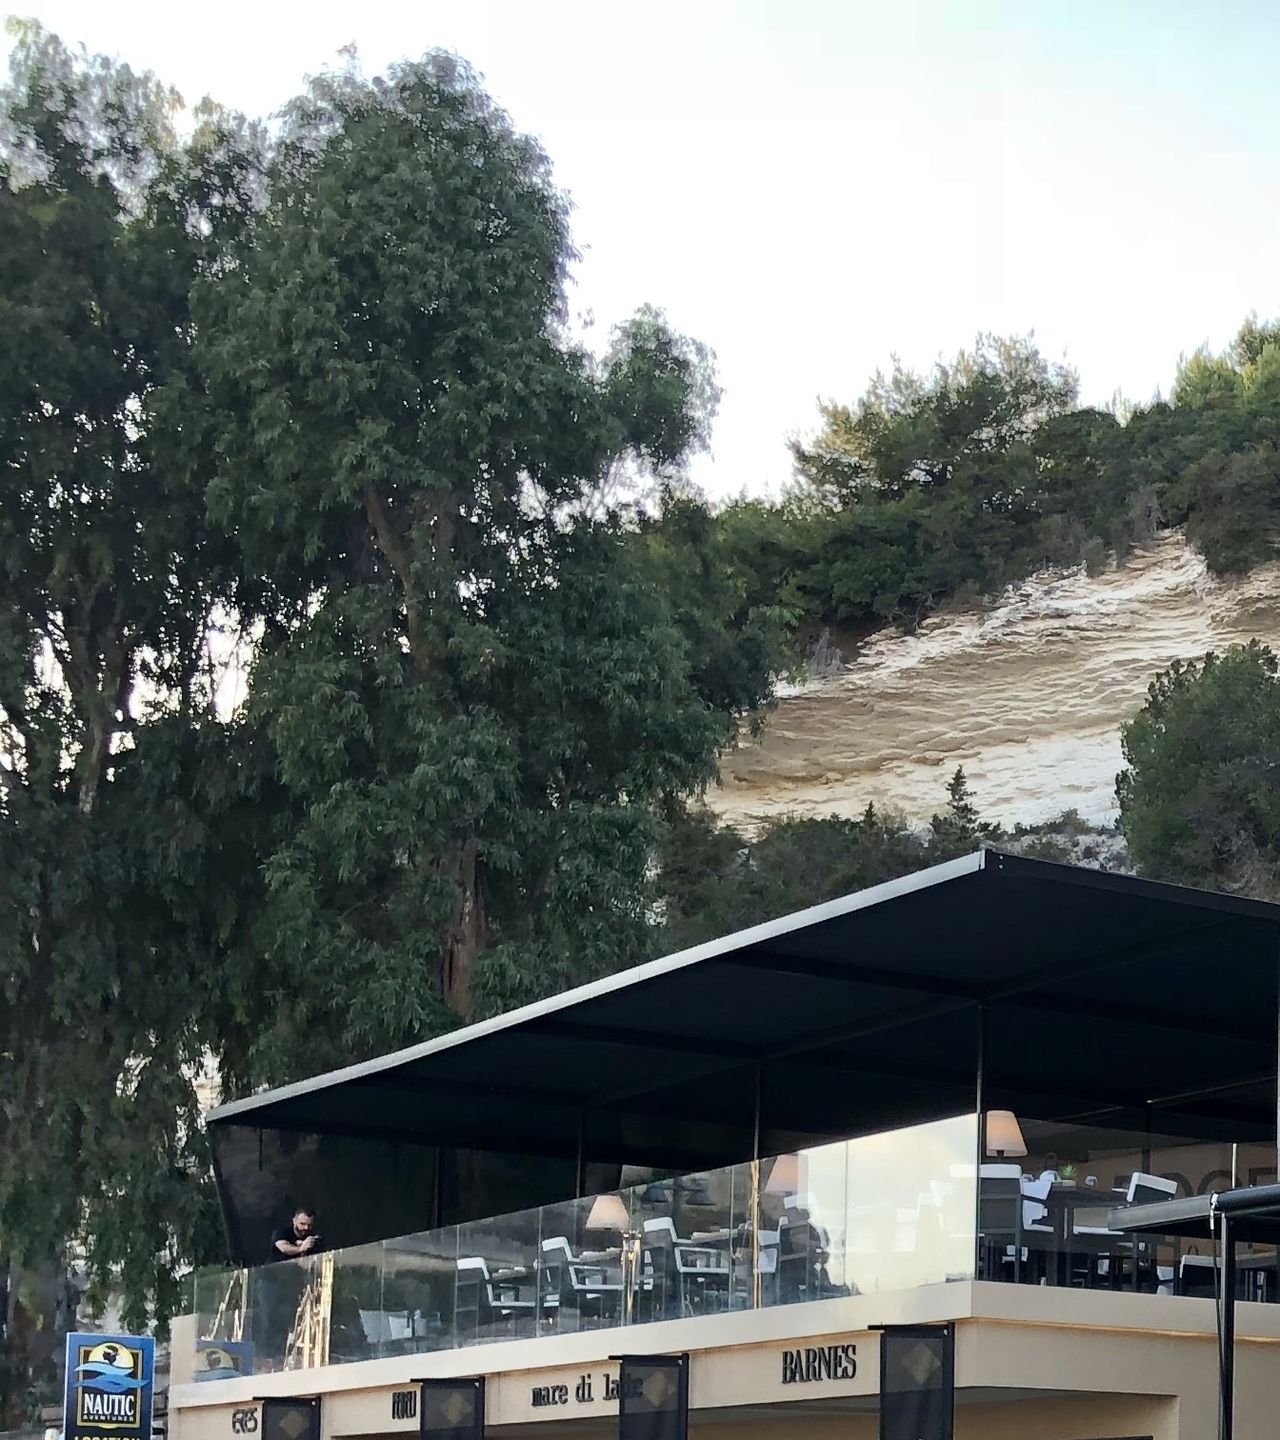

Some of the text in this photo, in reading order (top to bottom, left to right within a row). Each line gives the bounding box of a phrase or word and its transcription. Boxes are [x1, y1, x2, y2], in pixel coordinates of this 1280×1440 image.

[781, 1344, 857, 1385] BARNES
[83, 1393, 135, 1416] NAUTIC
[530, 1384, 568, 1407] mare
[575, 1373, 595, 1403] di
